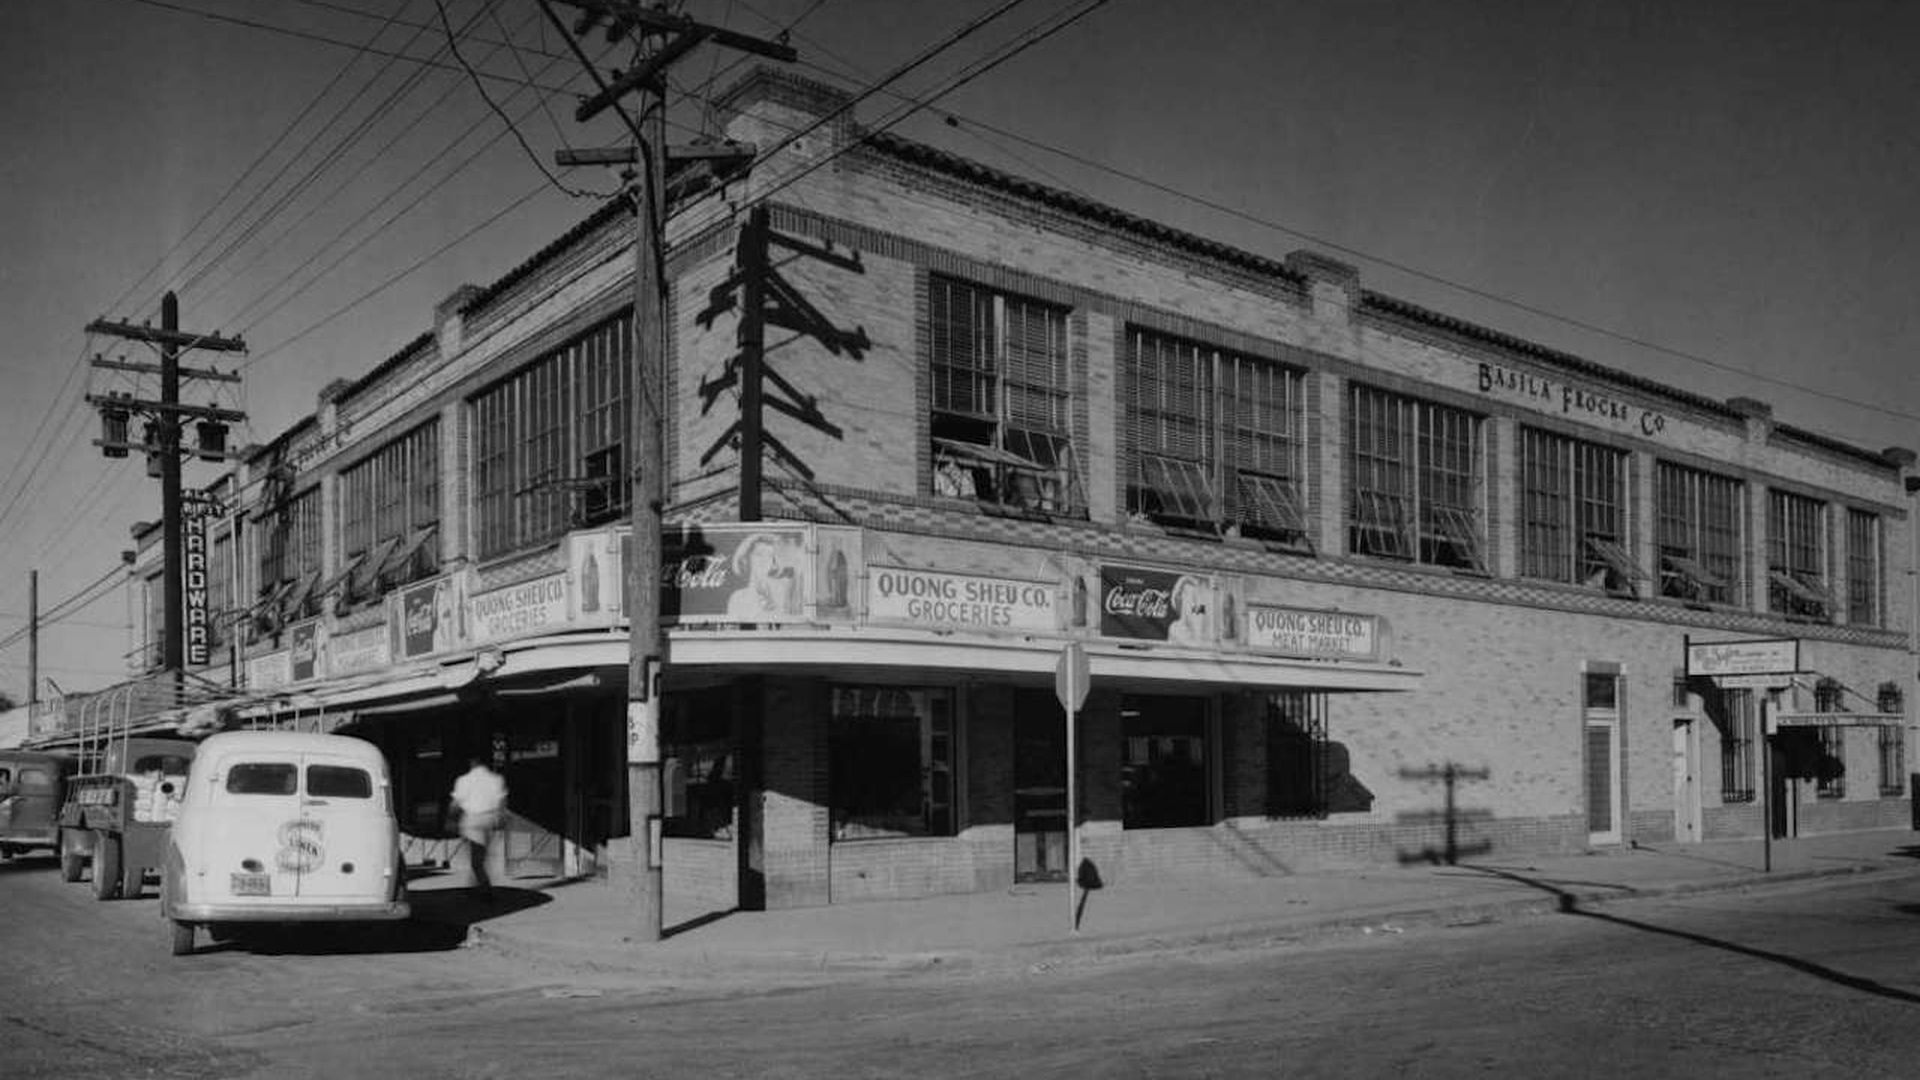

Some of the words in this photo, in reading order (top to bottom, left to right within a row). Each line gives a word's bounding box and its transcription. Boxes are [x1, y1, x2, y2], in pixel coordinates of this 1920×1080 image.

[186, 519, 209, 664] HARDWARE
[878, 572, 957, 600] QUONG
[965, 581, 1017, 605] SHEU
[908, 599, 1012, 627] GROCERIES
[1255, 612, 1306, 632] QUONG
[1308, 615, 1342, 635] SHEU
